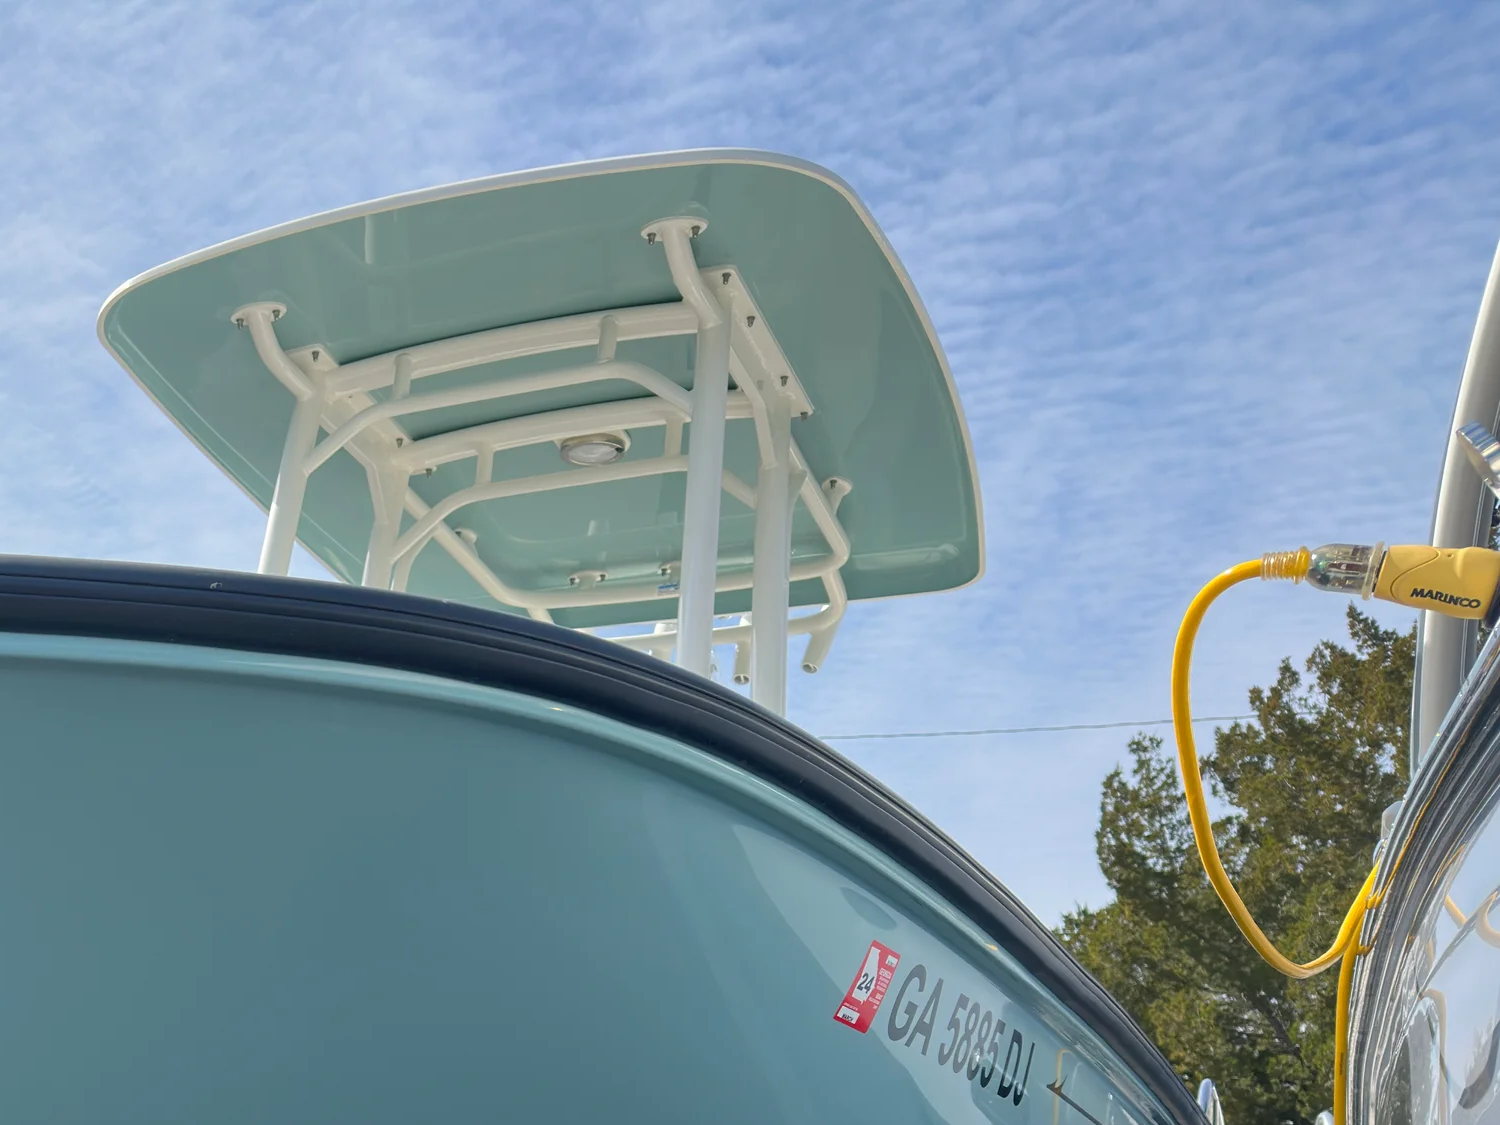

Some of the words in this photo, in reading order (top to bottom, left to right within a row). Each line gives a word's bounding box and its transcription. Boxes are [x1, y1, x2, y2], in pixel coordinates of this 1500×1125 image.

[1410, 588, 1481, 608] MARINCO
[856, 972, 875, 994] 24
[888, 964, 944, 1056] GA
[938, 993, 1006, 1088] 5885
[997, 1028, 1035, 1106] DJ
